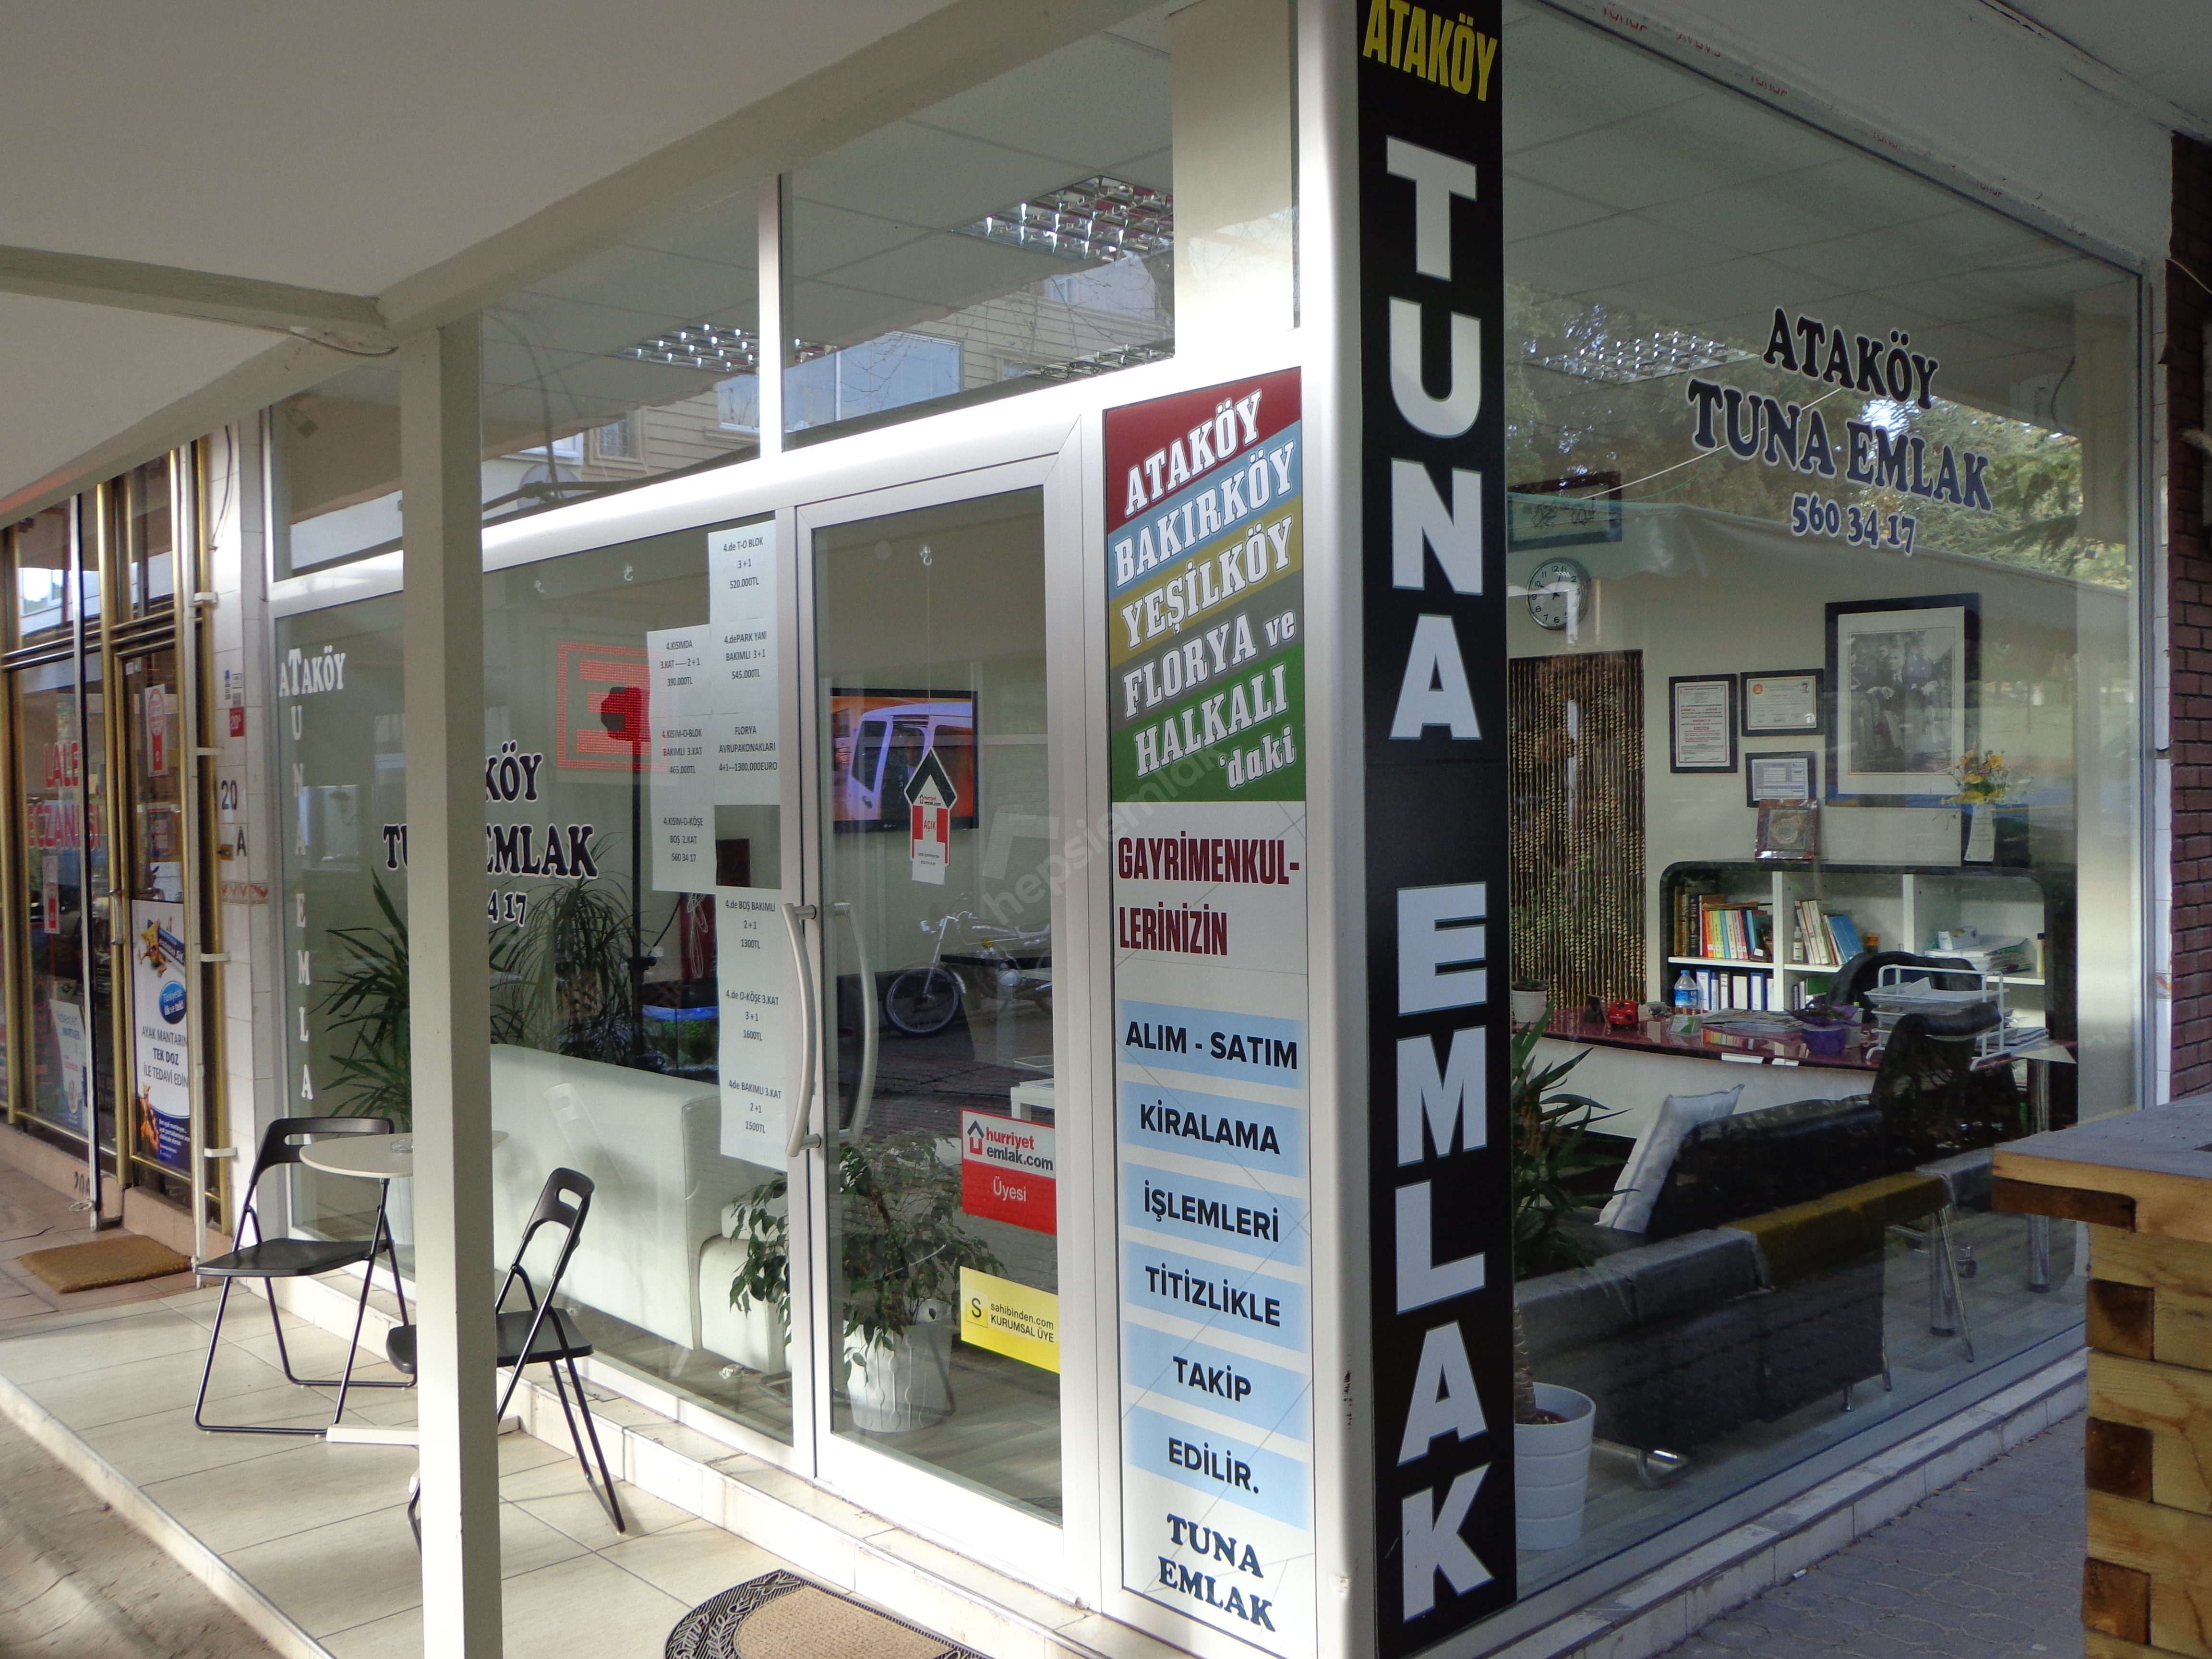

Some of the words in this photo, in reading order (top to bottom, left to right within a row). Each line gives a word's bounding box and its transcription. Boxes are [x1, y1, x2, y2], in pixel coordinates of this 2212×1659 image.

[1363, 0, 1498, 102] ATAKÖY
[1763, 306, 1939, 409] ATAKÖY
[1125, 390, 1262, 517] ATAKÖY
[1687, 379, 1837, 479] TUNA
[1846, 418, 1992, 513] EMLAK
[1114, 440, 1295, 589] BAKIRKÖY
[1791, 492, 1840, 537] 560
[1847, 505, 1879, 549] 34
[1887, 513, 1917, 556] 17
[748, 536, 763, 548] BLOK
[730, 577, 759, 589] 520.000TL
[1121, 515, 1293, 649] YEŞİLKÖY
[754, 631, 767, 641] YANI
[726, 651, 751, 661] BAKIMLI
[1123, 613, 1257, 719] FLORYA
[1265, 611, 1295, 648] ve
[279, 645, 346, 697] ATAKÖY
[668, 677, 693, 686] 390.000TL
[732, 669, 760, 679] 545.000TL
[735, 726, 757, 735] FLORYA
[1134, 662, 1287, 778] HALKALI
[663, 747, 685, 756] BAKIMLI
[719, 742, 776, 753] AVRUPAKONAKLARI
[221, 780, 238, 810] 20
[670, 835, 680, 845] BOŞ
[924, 820, 936, 832] AÇIK
[237, 826, 247, 857] A
[487, 823, 599, 879] MLAK
[672, 853, 681, 861] 560
[1118, 831, 1300, 885] GAYRİMENKUL-
[504, 891, 527, 927] 17
[739, 901, 750, 912] BOŞ
[752, 902, 775, 912] BAKIMLI
[1119, 901, 1227, 956] LERİNİZİN
[741, 939, 760, 949] 1300TL
[762, 995, 779, 1006] 3.KAT
[142, 1025, 156, 1041] AYAK
[743, 1029, 763, 1041] 1600TL
[1125, 1021, 1187, 1054] ALIM
[1210, 1031, 1297, 1070] SATIM
[153, 1047, 164, 1061] TEK
[166, 1051, 179, 1066] DOZ
[152, 1066, 173, 1084] TEDAVİ
[741, 1082, 764, 1095] BAKIMLI
[765, 1087, 781, 1099] 3.KAT
[745, 1121, 766, 1133] 1500TL
[986, 1126, 1034, 1150] hurriyet
[1140, 1099, 1281, 1155] KİRALAMA
[986, 1145, 1053, 1171] emlak.com
[993, 1176, 1027, 1202] Üyesi
[1143, 1179, 1279, 1243] İŞLEMLERİ
[1144, 1262, 1280, 1327] TİTİZLİKLE
[990, 1301, 1054, 1330] sahibinden.com
[990, 1313, 1035, 1337] KURUMSAL
[1037, 1326, 1054, 1343] ÜYE
[1173, 1355, 1252, 1402] TAKİP
[1168, 1436, 1259, 1494] EDİLİR.
[1166, 1513, 1264, 1579] TUNA
[1158, 1555, 1275, 1633] EMLAK
